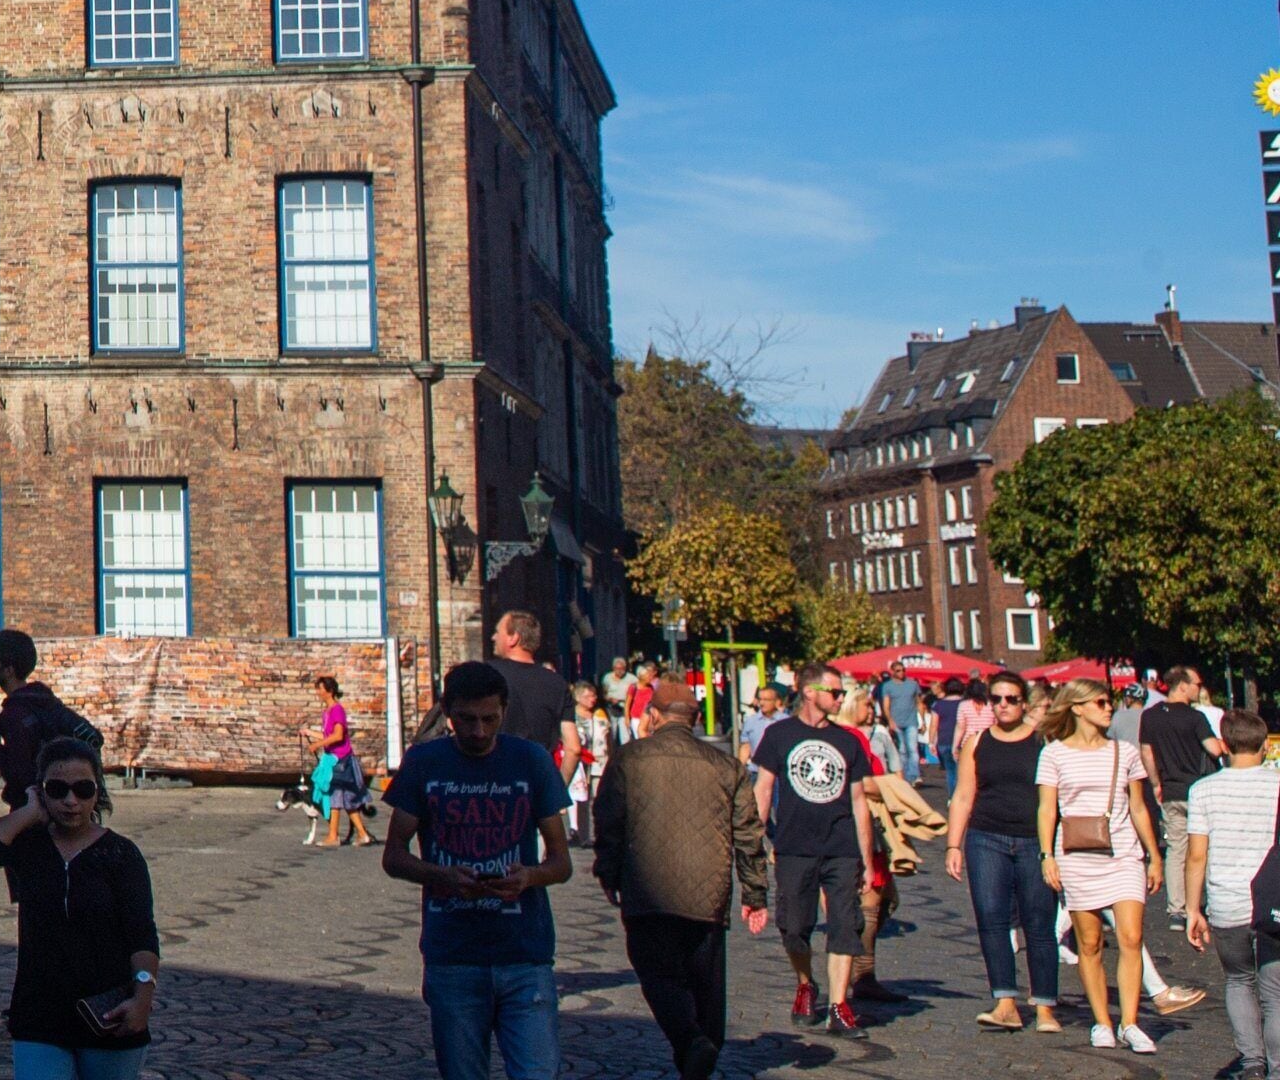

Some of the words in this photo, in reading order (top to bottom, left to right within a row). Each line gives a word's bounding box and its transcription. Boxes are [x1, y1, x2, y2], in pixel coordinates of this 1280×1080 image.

[440, 781, 459, 796] The
[460, 781, 489, 795] brand
[445, 796, 506, 825] SAN
[431, 840, 520, 877] CALORNIA
